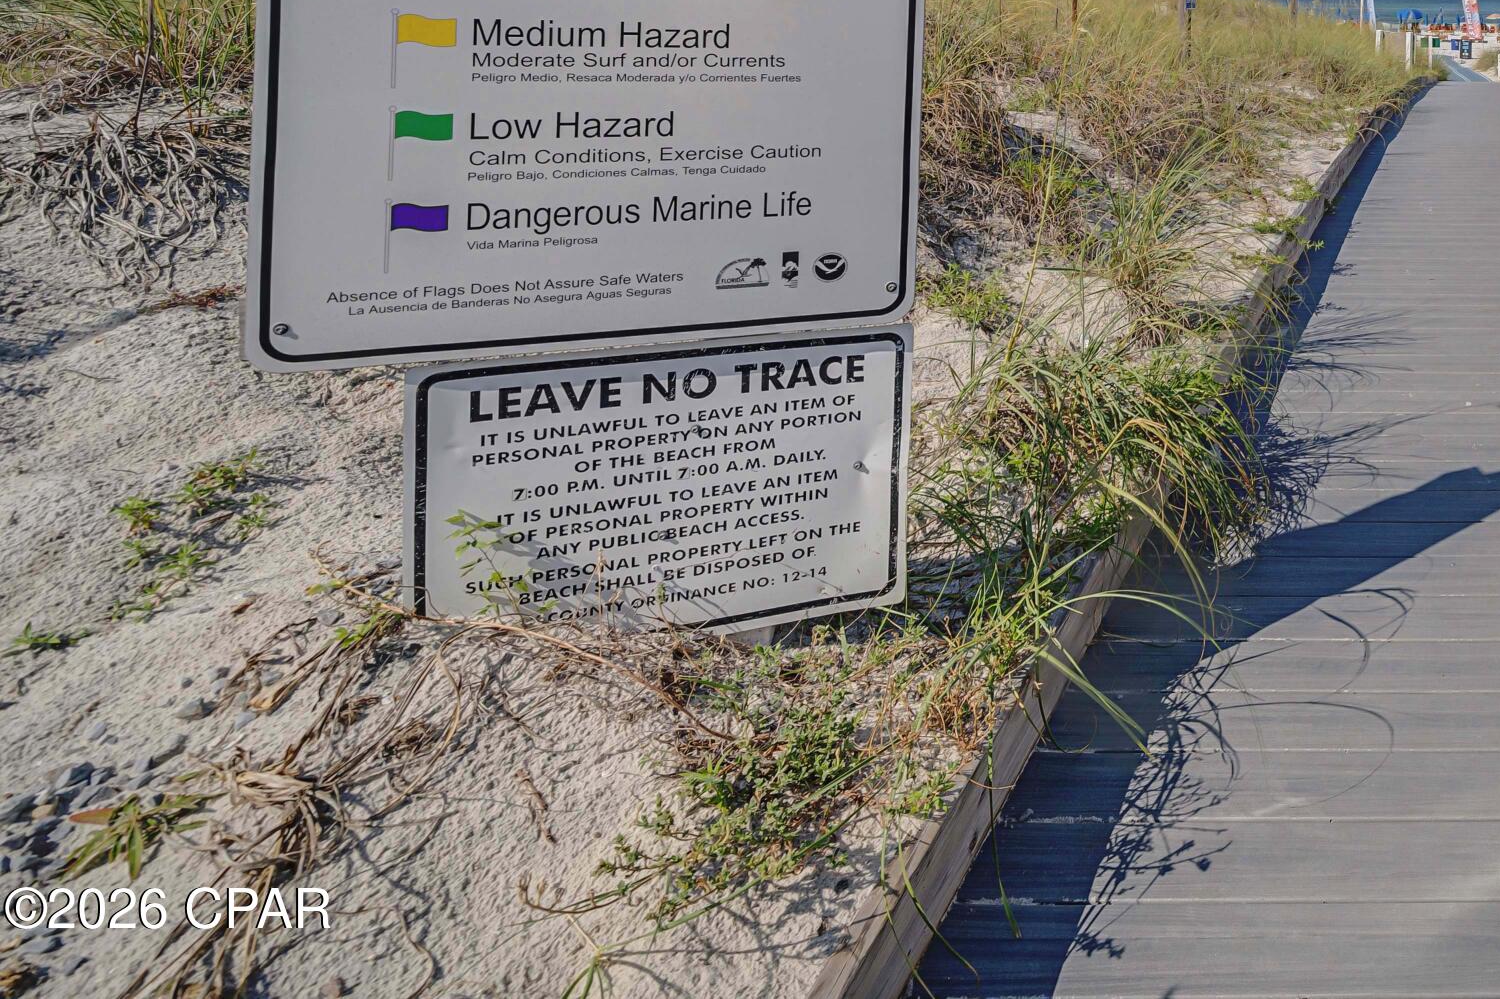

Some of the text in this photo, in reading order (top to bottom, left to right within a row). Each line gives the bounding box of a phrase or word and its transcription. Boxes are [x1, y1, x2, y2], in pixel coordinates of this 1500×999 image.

[474, 19, 730, 49] Medium Hazard
[473, 53, 785, 67] Moderate Surf and/or Currents
[472, 73, 516, 84] Peligro
[567, 73, 612, 82] Resaca
[617, 74, 675, 82] Moderada
[679, 74, 696, 84] y/o
[700, 74, 757, 82] Corrientes
[761, 74, 801, 82] Fuertes
[471, 111, 674, 140] Low Hazard
[470, 145, 821, 166] Calm Conditions, Exercise Caution
[468, 172, 512, 183] Peligro
[552, 168, 627, 180] Condiciones
[682, 167, 716, 176] Tenga
[720, 165, 766, 174] Cuidado
[467, 191, 811, 235] Dangerous Marine Life
[467, 237, 598, 250] Vida Marina Peligrosa
[327, 273, 684, 303] Absence of Flags Does Not Assure Safe Waters
[349, 288, 672, 316] La Ausencia de Banderas No Asegura Aguas Seguras
[469, 355, 865, 422] LEAVE NO TRACE
[473, 411, 861, 466] PERSONAL PROPERTY ON ANY PORTION
[481, 395, 855, 447] IT IS UNLAWFUL TO LEAVE AN ITEM OF
[575, 438, 775, 473] OF THE BEACH FROM
[514, 450, 826, 501] 7:00 P.M. UNTIL 7:00 A.M. DAILY.
[497, 470, 838, 527] IT IS UNLAWFUL TO LEAVE AN ITEM
[507, 488, 828, 544] OF PERSONAL PROPERTY WITHIN
[536, 510, 804, 560] ANY PUBLIC BEACH ACCESS.
[465, 522, 860, 597] SUCH PERSONAL PROPERTY LEFT ON THE
[520, 583, 586, 605] BEACH
[594, 573, 656, 593] SHALL
[664, 568, 685, 581] BE
[693, 551, 785, 577] DISPOSED
[744, 578, 774, 590] NO:
[783, 567, 827, 583] 12-14
